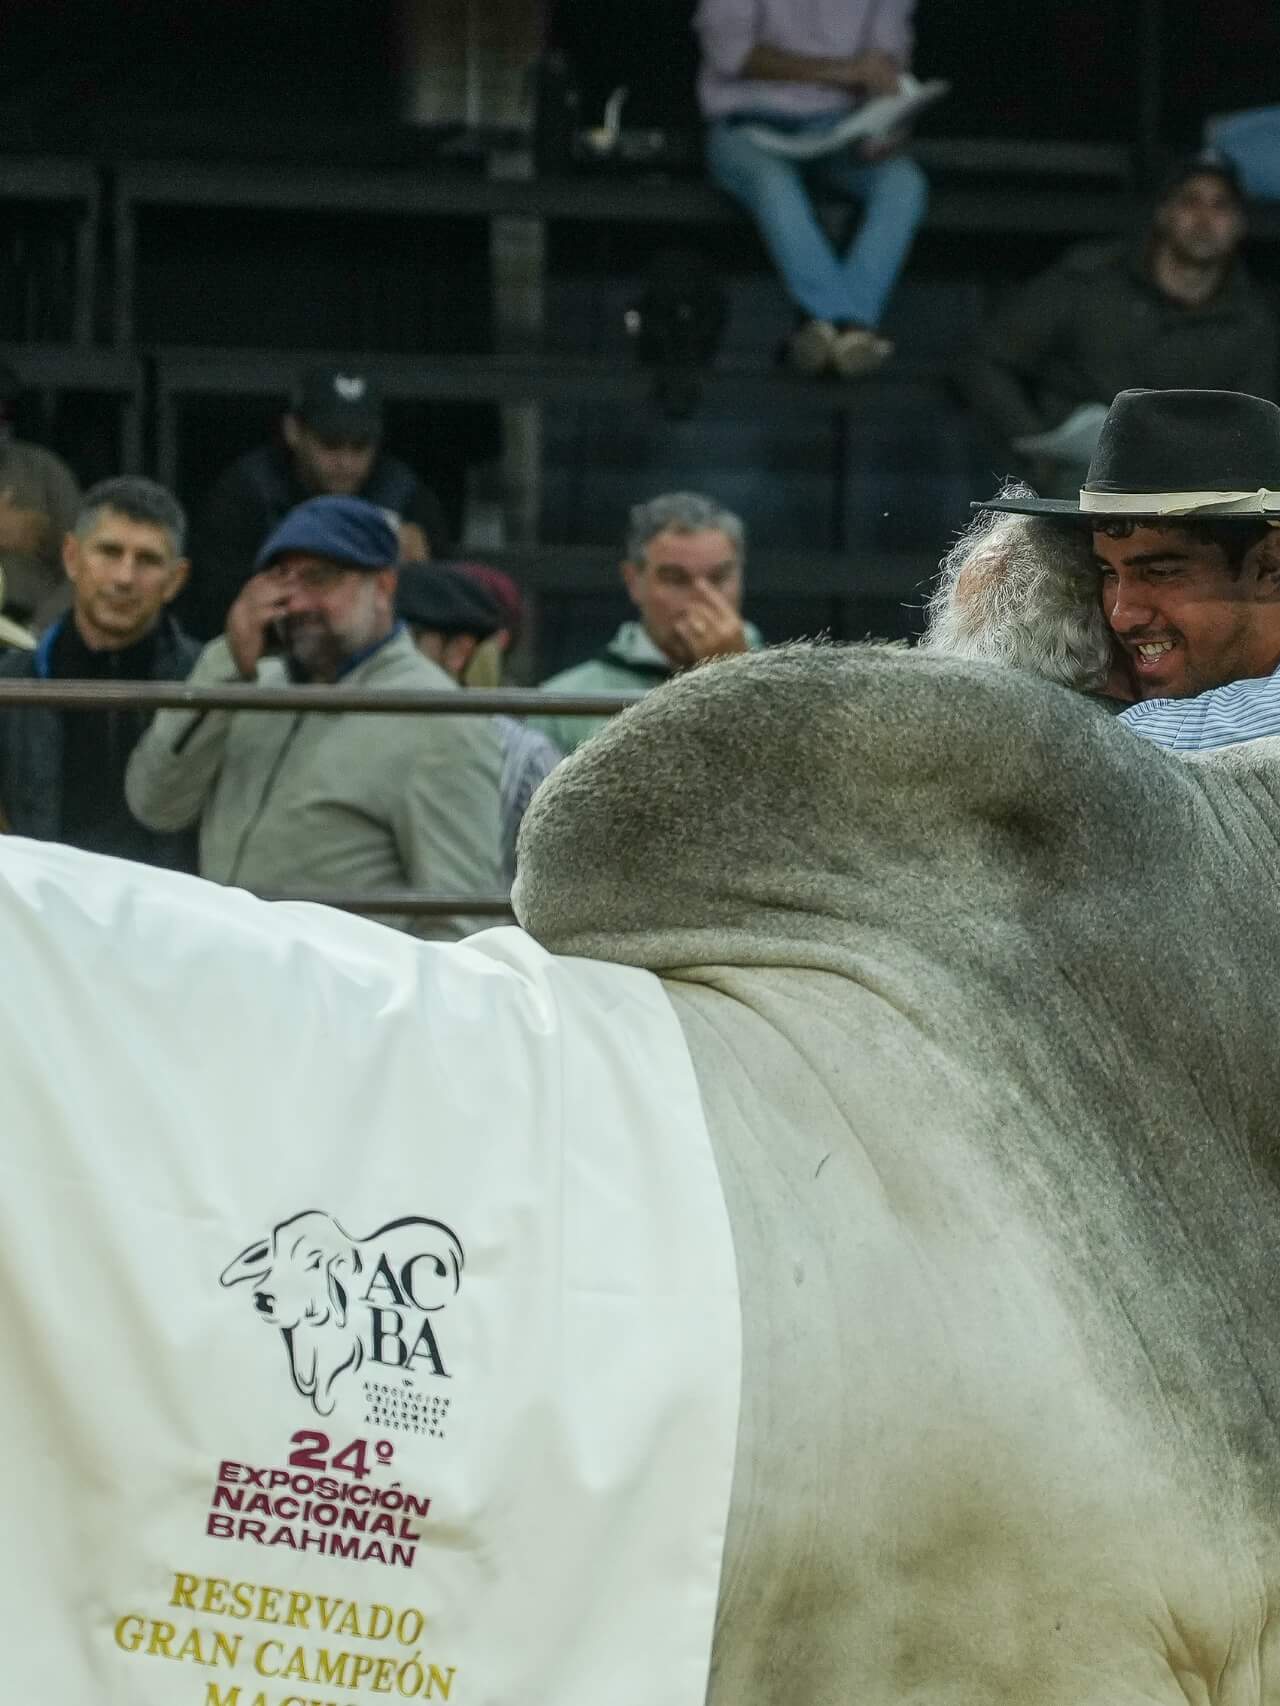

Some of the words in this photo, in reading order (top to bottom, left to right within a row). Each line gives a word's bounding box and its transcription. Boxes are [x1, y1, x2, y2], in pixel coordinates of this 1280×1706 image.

[361, 1253, 447, 1311] AC
[366, 1304, 452, 1378] BA
[212, 1486, 421, 1540] NACIONAL
[217, 1461, 430, 1518] EXPOSICIÓN
[205, 1513, 416, 1568] BRAHMAN
[168, 1571, 426, 1647] RESERVADO
[114, 1613, 243, 1668] GRAN
[253, 1640, 457, 1701] CAMPEÓN
